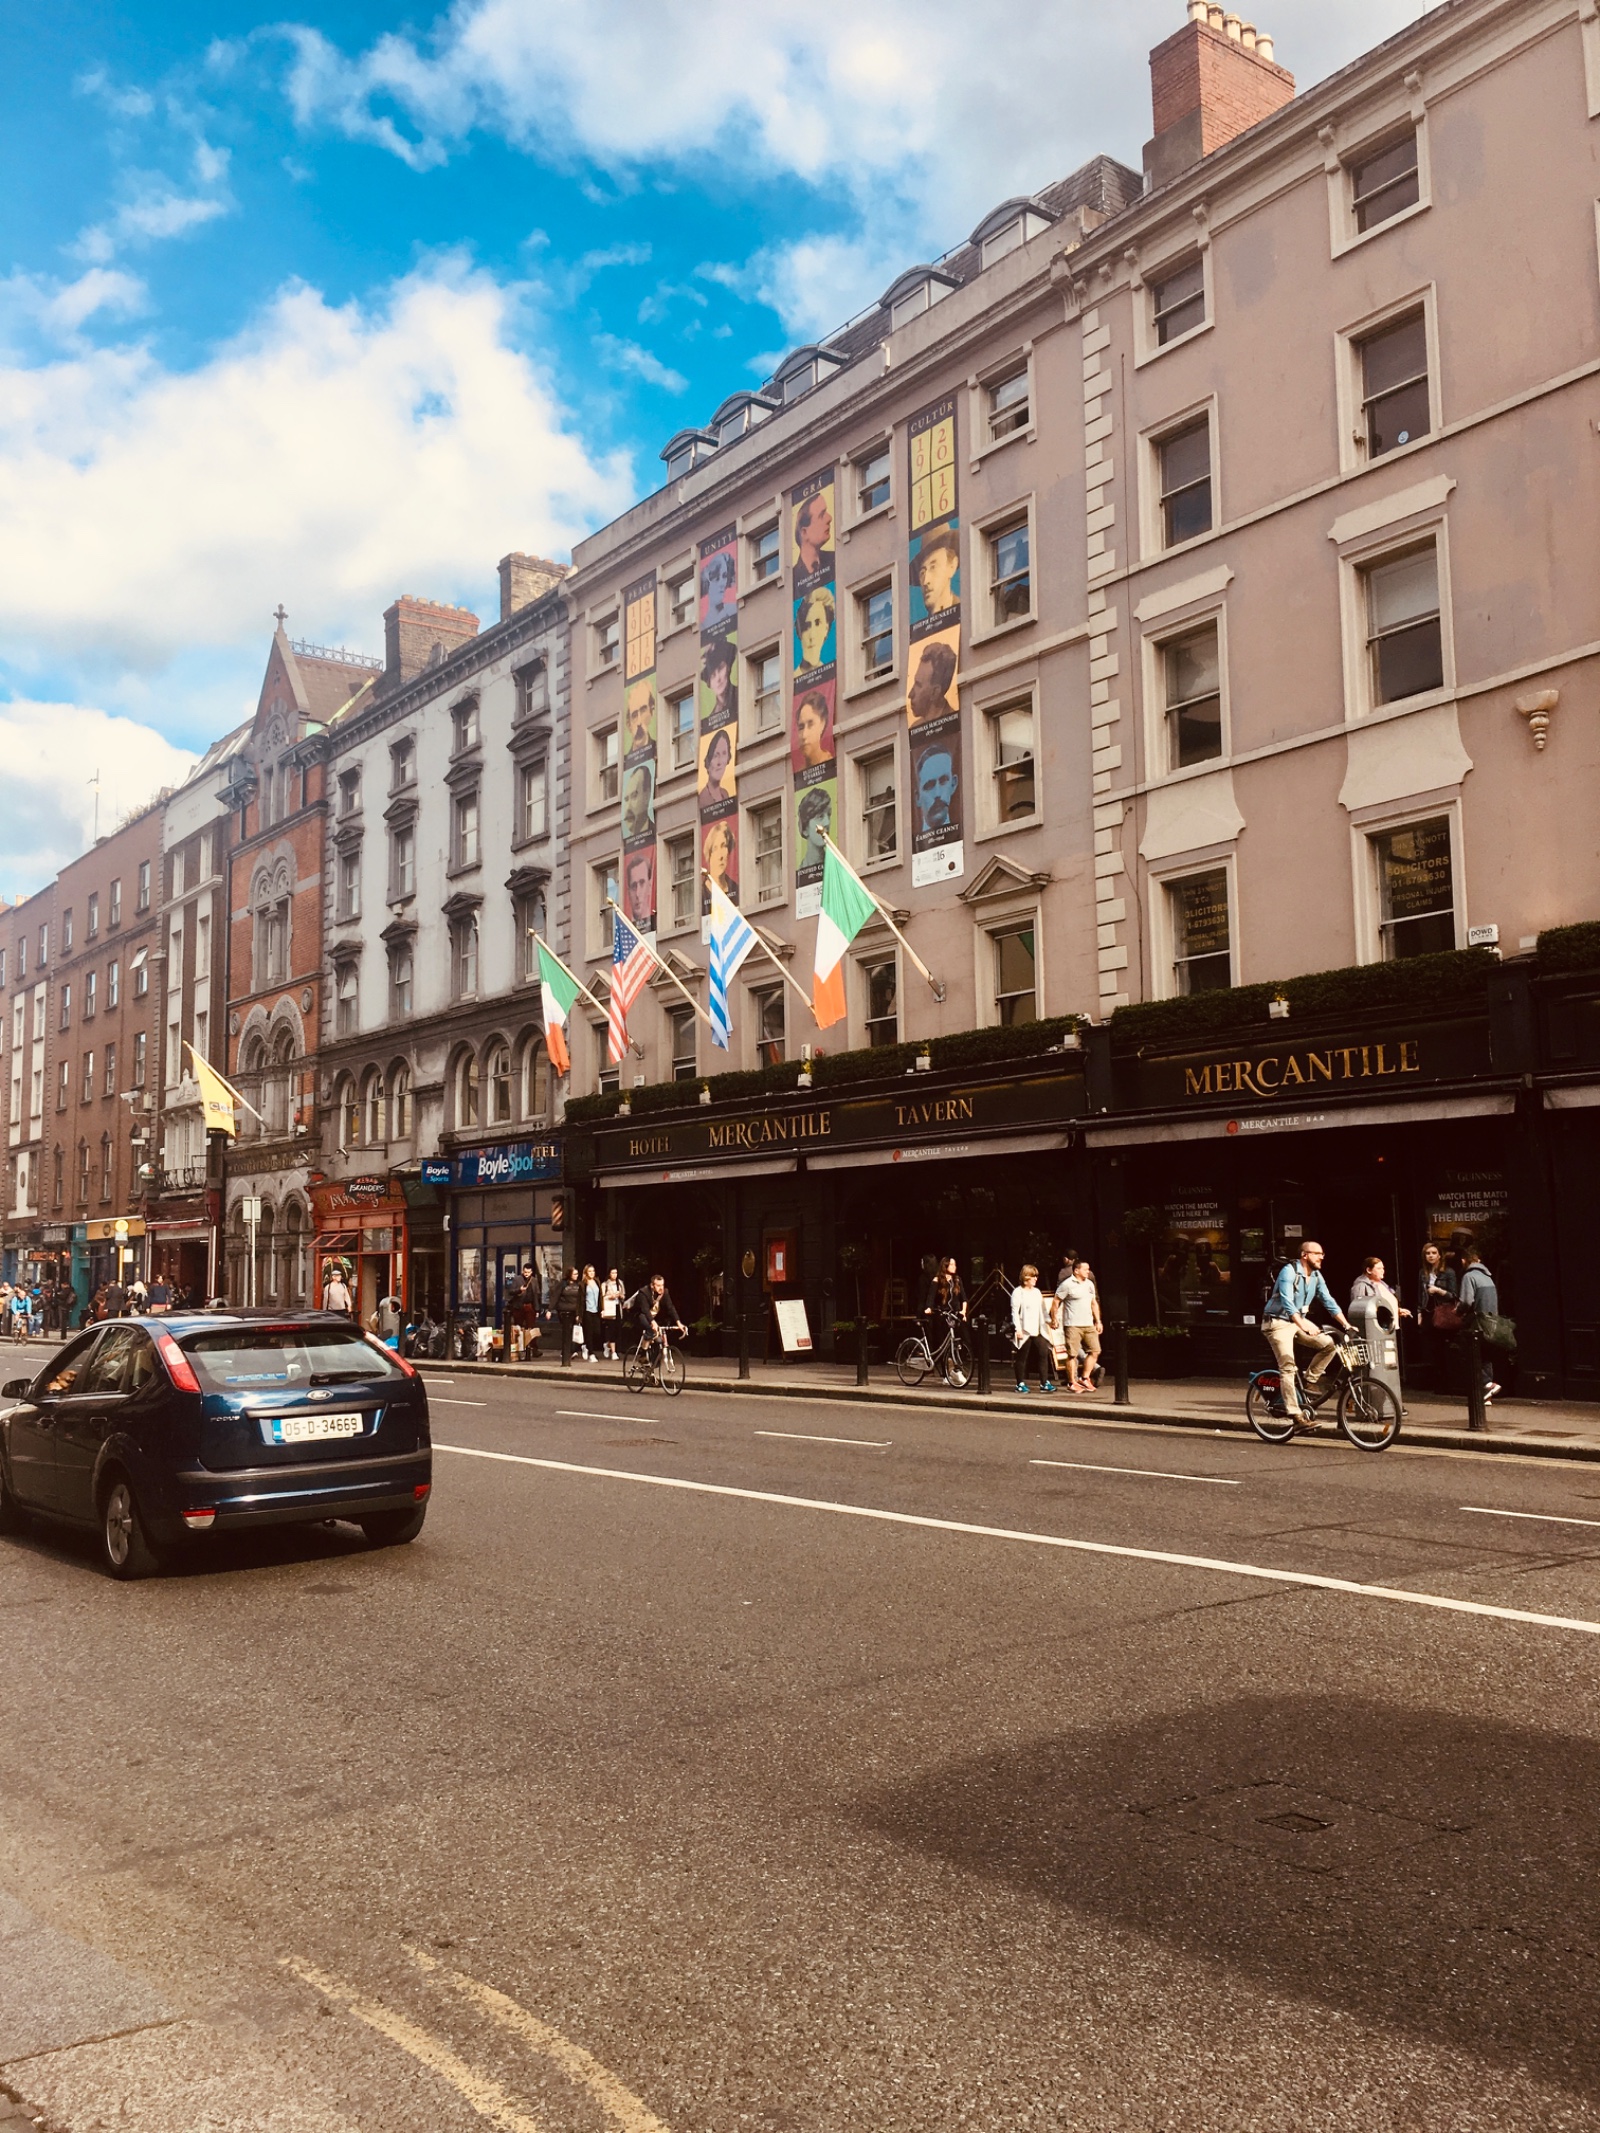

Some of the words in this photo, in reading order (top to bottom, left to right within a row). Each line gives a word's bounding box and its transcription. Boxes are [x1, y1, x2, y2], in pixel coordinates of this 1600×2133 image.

[802, 476, 822, 497] GRÁ
[704, 532, 733, 555] UNITY
[628, 580, 653, 601] PEACE
[929, 606, 957, 623] PLUNKETT
[935, 823, 960, 835] CEANNT
[1387, 855, 1450, 876] SOLICITORS
[1405, 897, 1433, 909] CLAIMS
[1183, 902, 1228, 919] OLICITORS
[1470, 927, 1493, 937] DOWD
[1183, 1039, 1421, 1097] MERCANTILE
[894, 1096, 975, 1127] TAVERN
[1240, 1116, 1300, 1131] MERCANTILE
[1306, 1114, 1325, 1123] BAR
[629, 1136, 672, 1157] HOTEL
[708, 1111, 831, 1150] MERCANTILE
[902, 1147, 941, 1159] MERCANTILE
[426, 1165, 450, 1177] Boyle
[1456, 1170, 1503, 1182] GUINNESS
[429, 1175, 449, 1183] Sports
[1437, 1191, 1465, 1201] WATCH
[1466, 1191, 1482, 1200] THE
[1164, 1202, 1184, 1211] WATCH
[1184, 1202, 1197, 1210] THE
[1197, 1202, 1218, 1210] MATCH
[1449, 1200, 1468, 1209] LIVE
[1468, 1200, 1490, 1208] HERE
[1490, 1199, 1500, 1207] IN
[1172, 1209, 1186, 1218] LIVE
[1202, 1209, 1210, 1217] IN
[1432, 1213, 1453, 1223] THE
[1176, 1219, 1225, 1229] MERCANTILE
[284, 1417, 358, 1437] 05-D-34669
